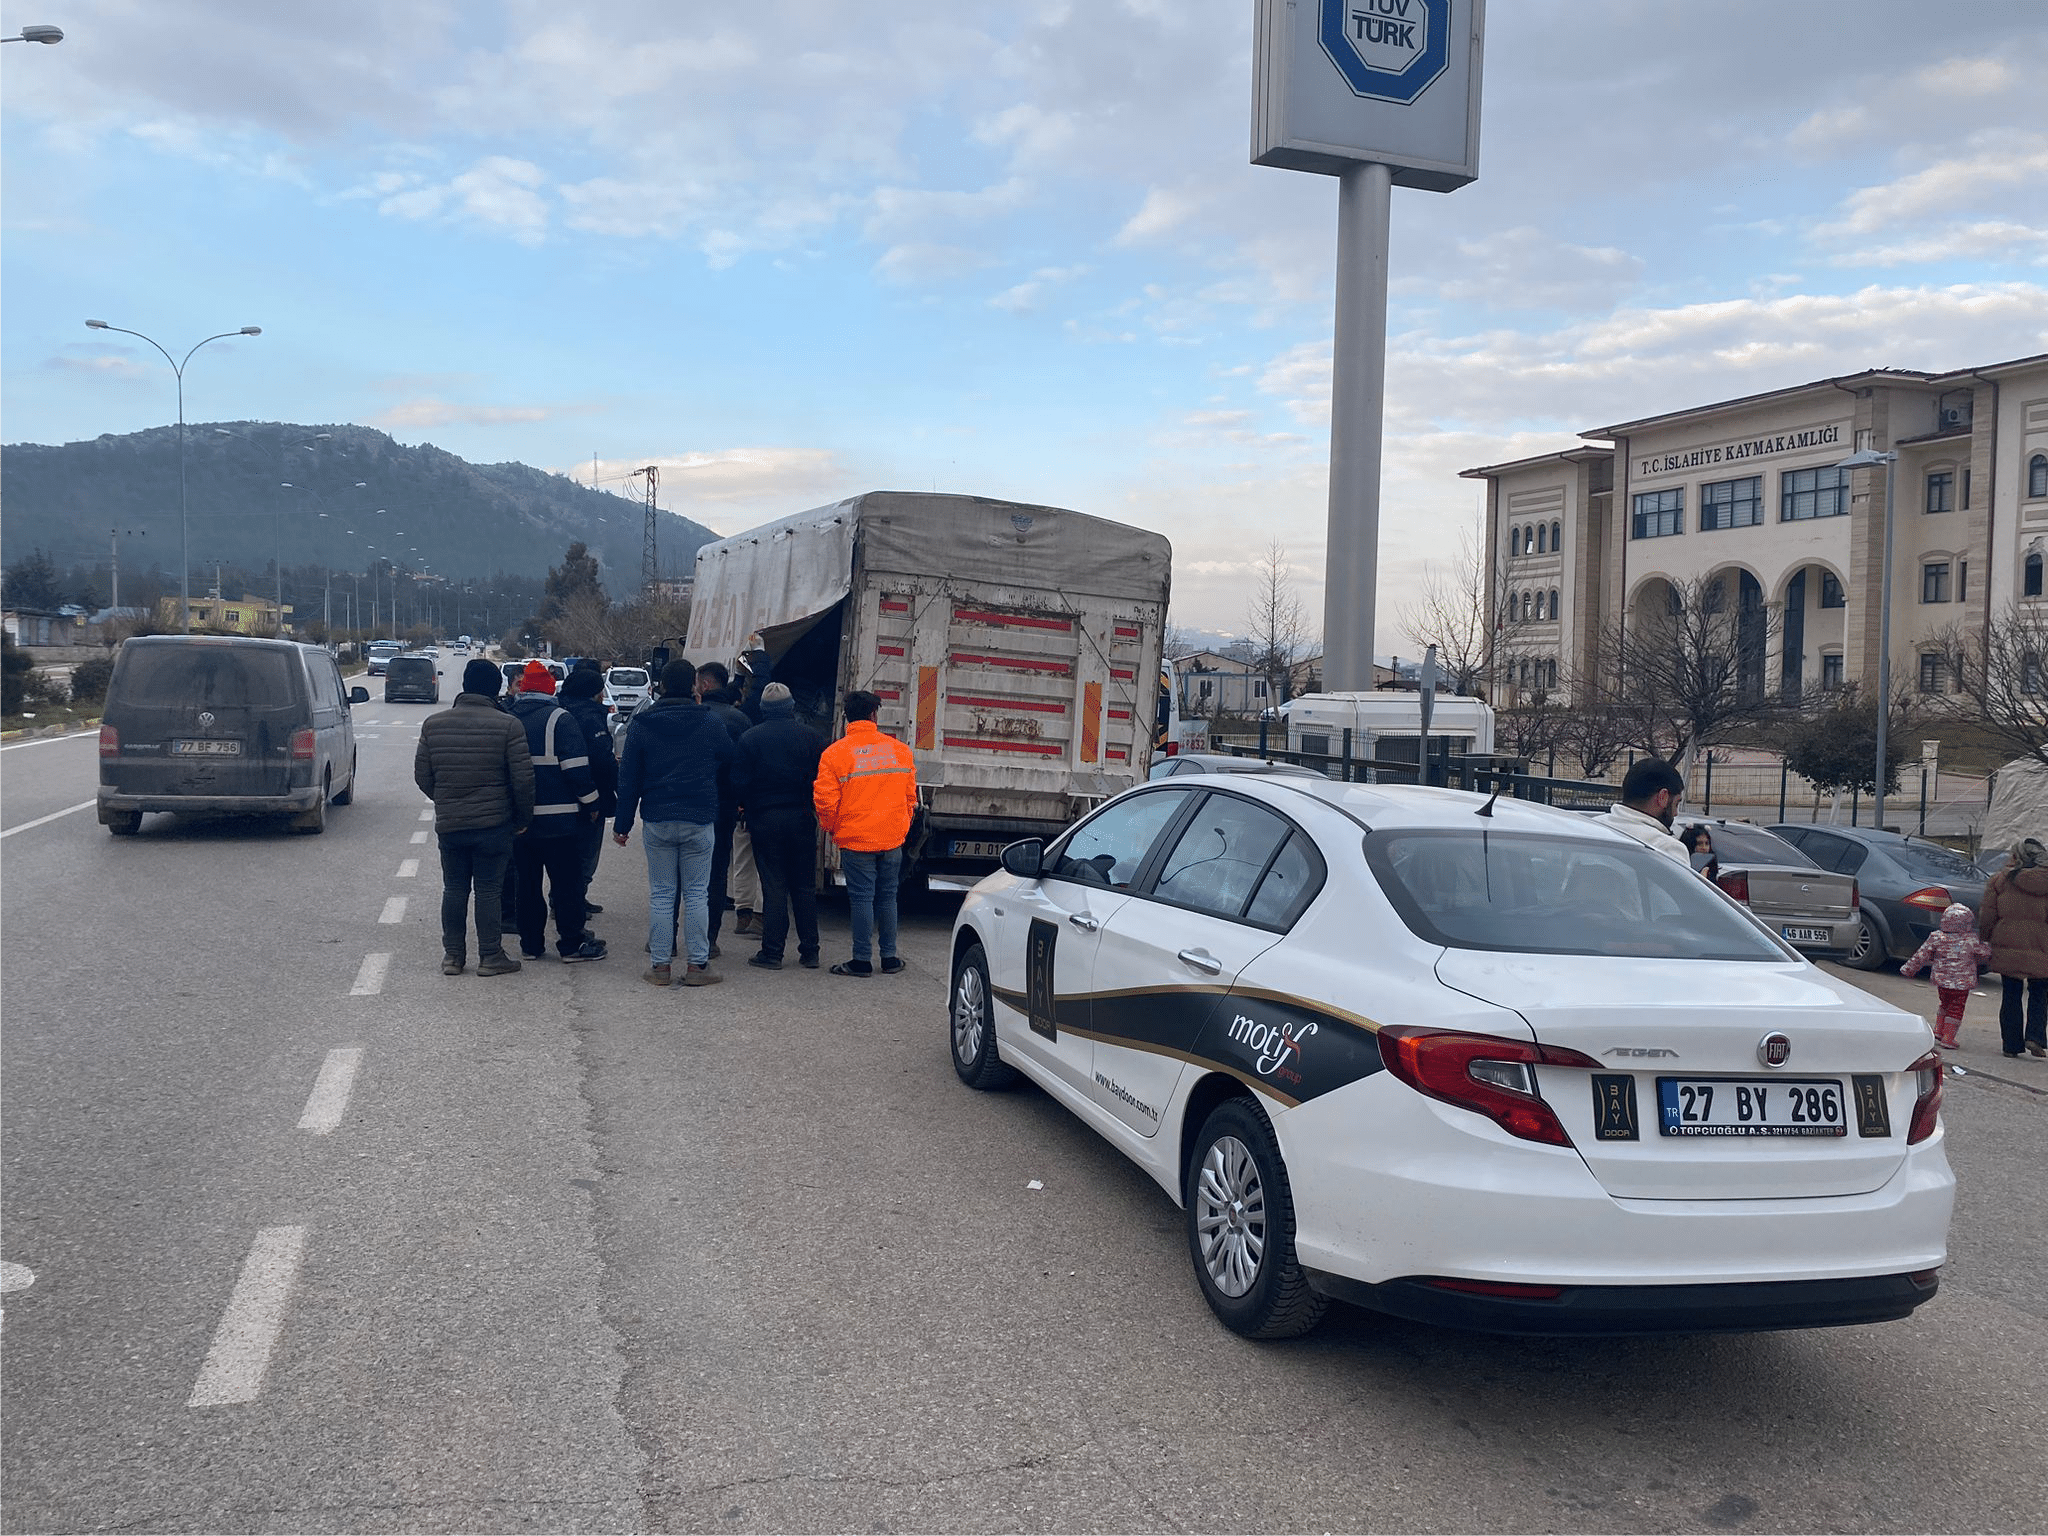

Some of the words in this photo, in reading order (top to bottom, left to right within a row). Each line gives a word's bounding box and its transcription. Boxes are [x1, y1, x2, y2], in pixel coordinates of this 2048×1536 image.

[1352, 14, 1415, 49] TÜRK
[1664, 448, 1722, 471] İSLAHİYE
[1725, 424, 1839, 461] KAYMAKAMLIĞI
[180, 742, 193, 751] 77
[217, 743, 237, 752] 756
[955, 842, 967, 853] 27
[974, 843, 981, 854] R
[1787, 929, 1797, 938] 46
[1814, 931, 1828, 940] 556
[1769, 1042, 1786, 1059] FIAT
[1095, 1071, 1158, 1123] www.baydoor.com.tr
[1680, 1086, 1713, 1121] 27
[1736, 1086, 1767, 1121] BY
[1788, 1087, 1838, 1122] 286
[1666, 1107, 1679, 1117] TR
